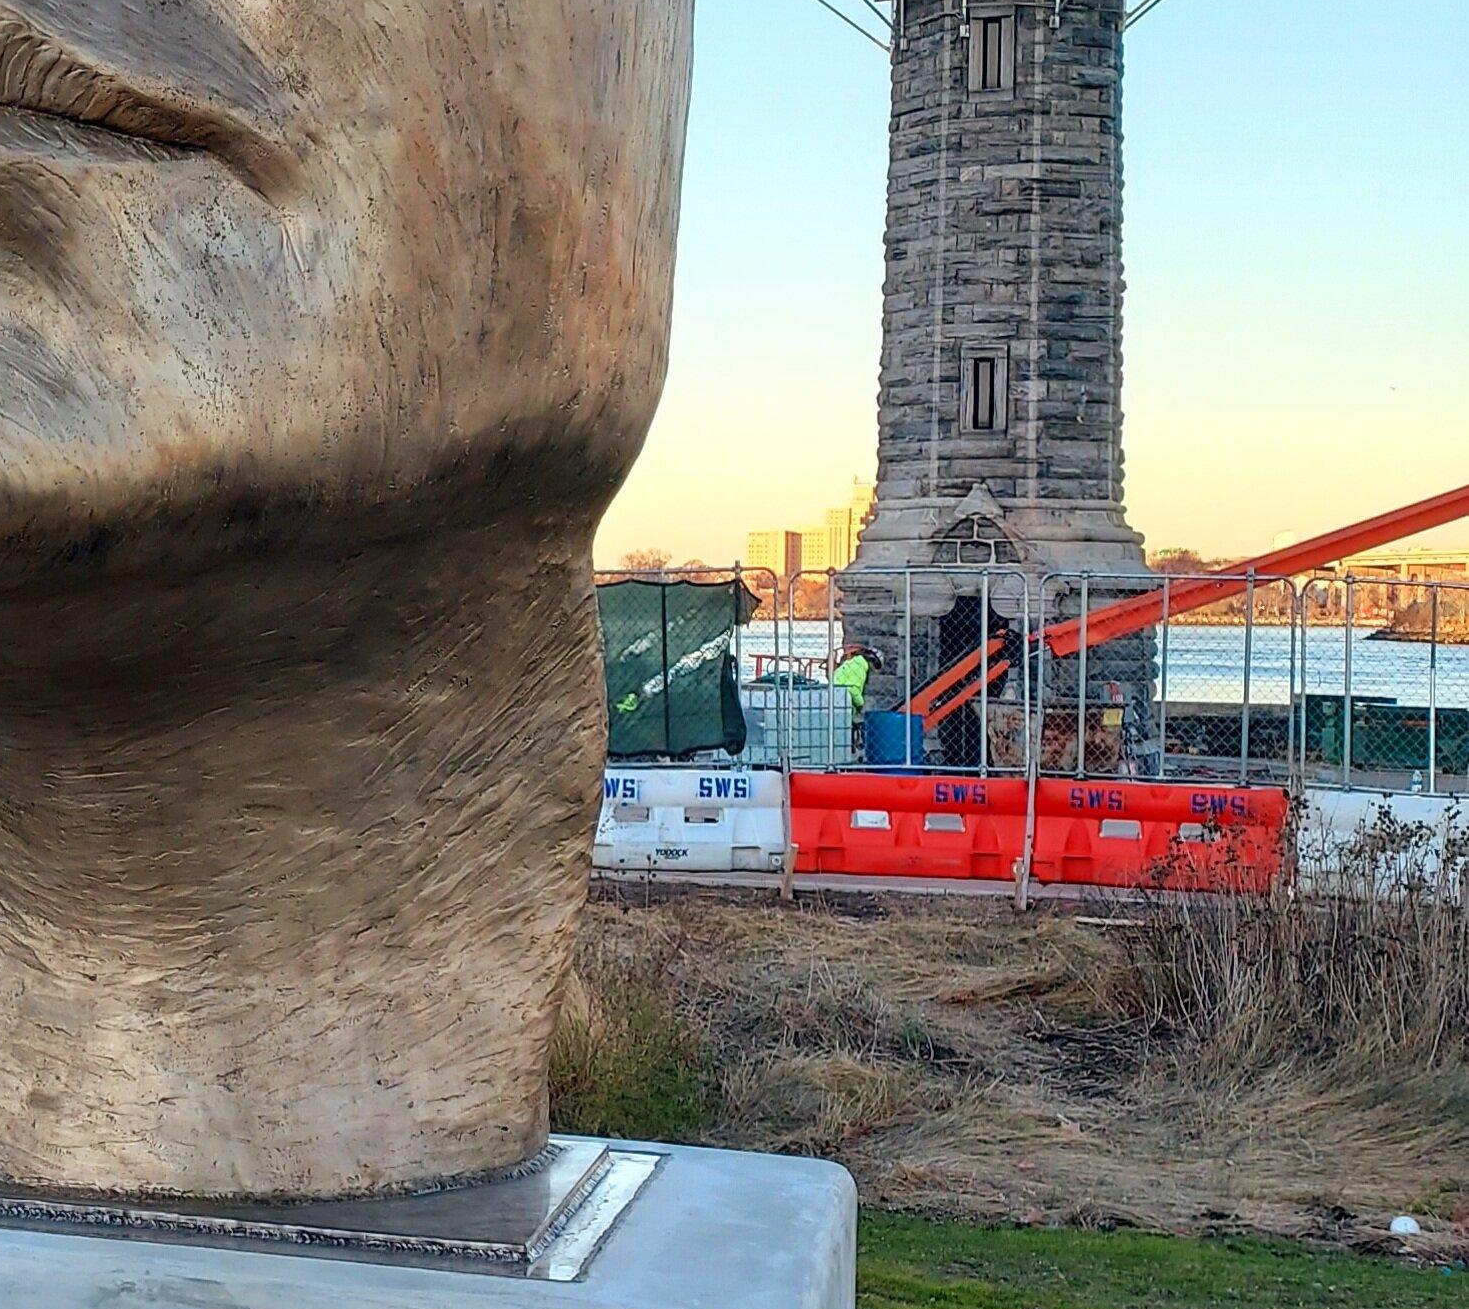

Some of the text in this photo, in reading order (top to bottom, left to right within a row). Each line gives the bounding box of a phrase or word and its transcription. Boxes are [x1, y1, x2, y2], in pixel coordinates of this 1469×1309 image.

[604, 777, 636, 799] WS
[699, 776, 747, 799] SWS
[934, 782, 987, 805] SWS
[1069, 787, 1122, 811] SWS
